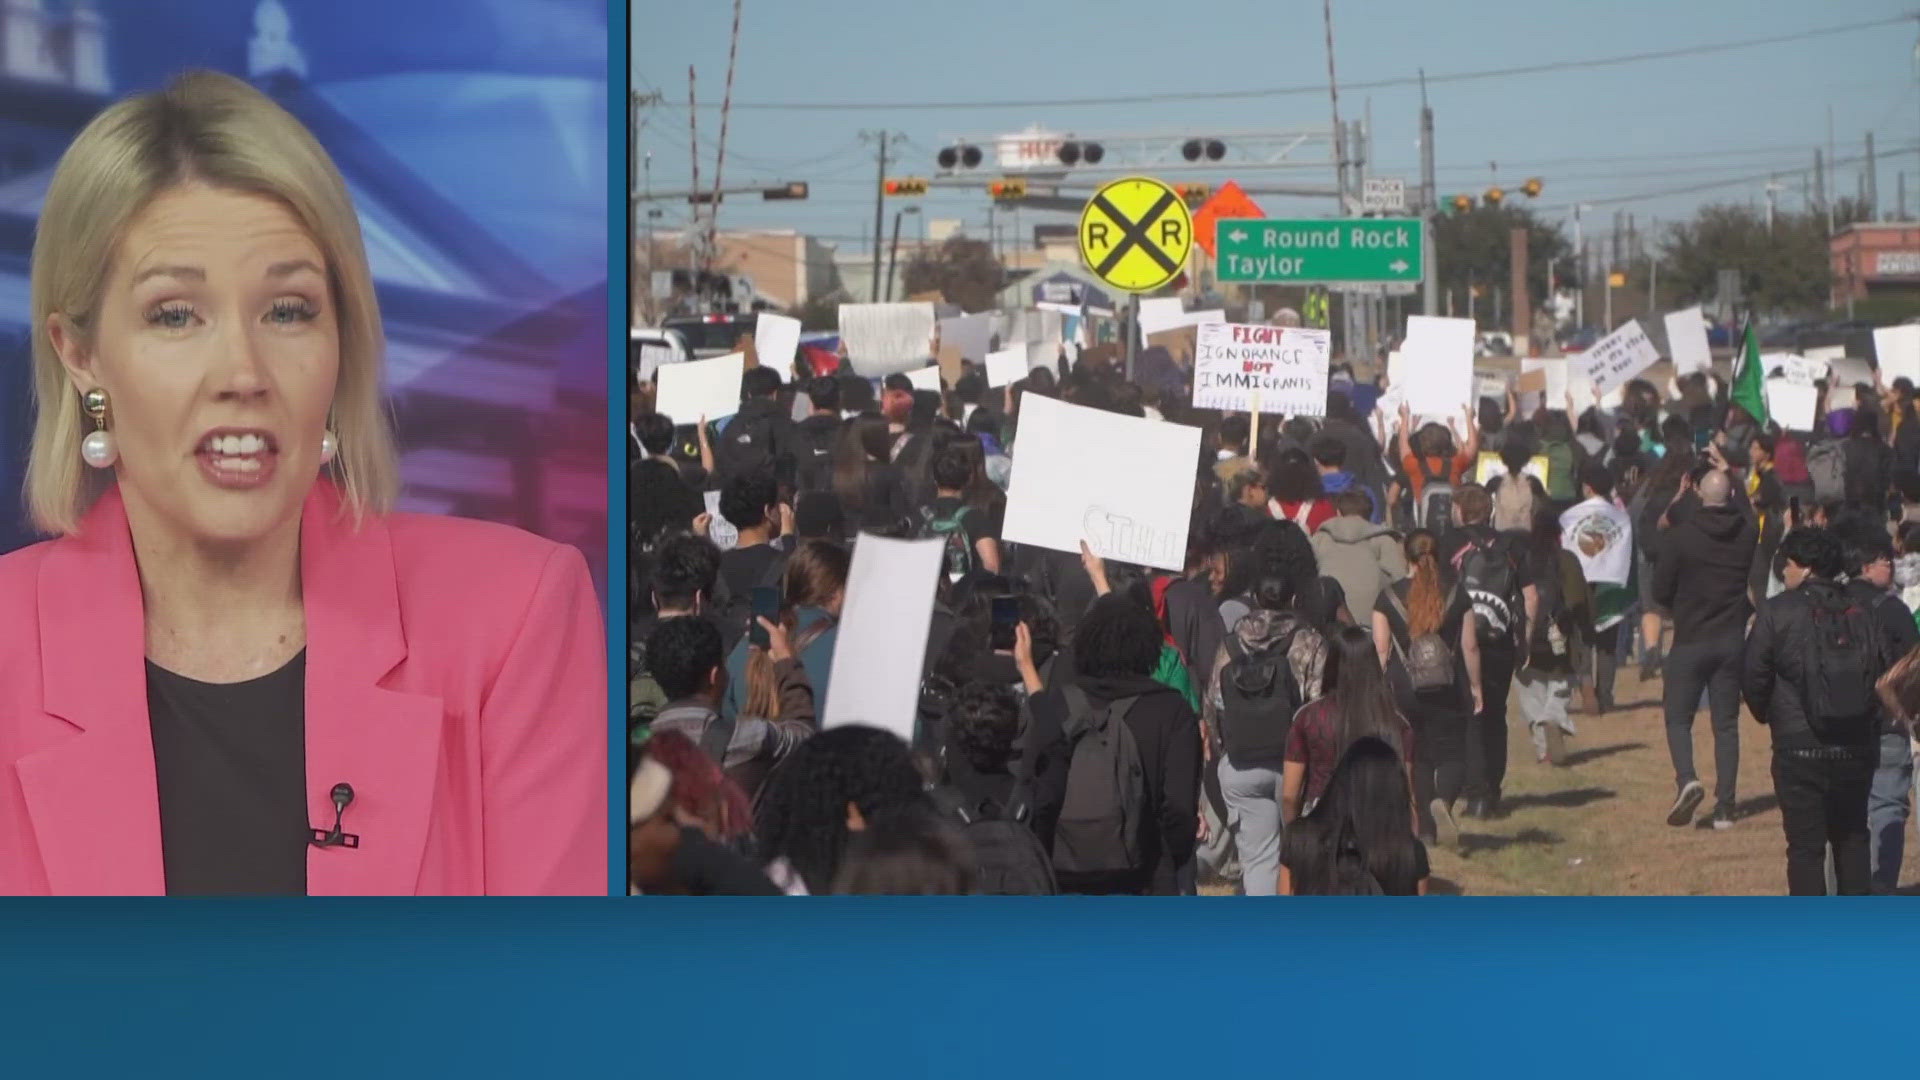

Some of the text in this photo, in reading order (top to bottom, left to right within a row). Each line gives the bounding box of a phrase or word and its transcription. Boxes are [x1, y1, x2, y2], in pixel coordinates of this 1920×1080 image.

[1366, 182, 1400, 193] TRUCK
[1366, 195, 1400, 206] ROUTE
[1088, 219, 1182, 249] R R
[1263, 227, 1409, 248] Round Rock
[1228, 253, 1304, 279] Taylor
[1233, 326, 1284, 345] FIGHT
[1200, 344, 1303, 364] IGNORANCE
[1242, 360, 1273, 374] NOT
[1201, 371, 1312, 390] IMMIGRANTS
